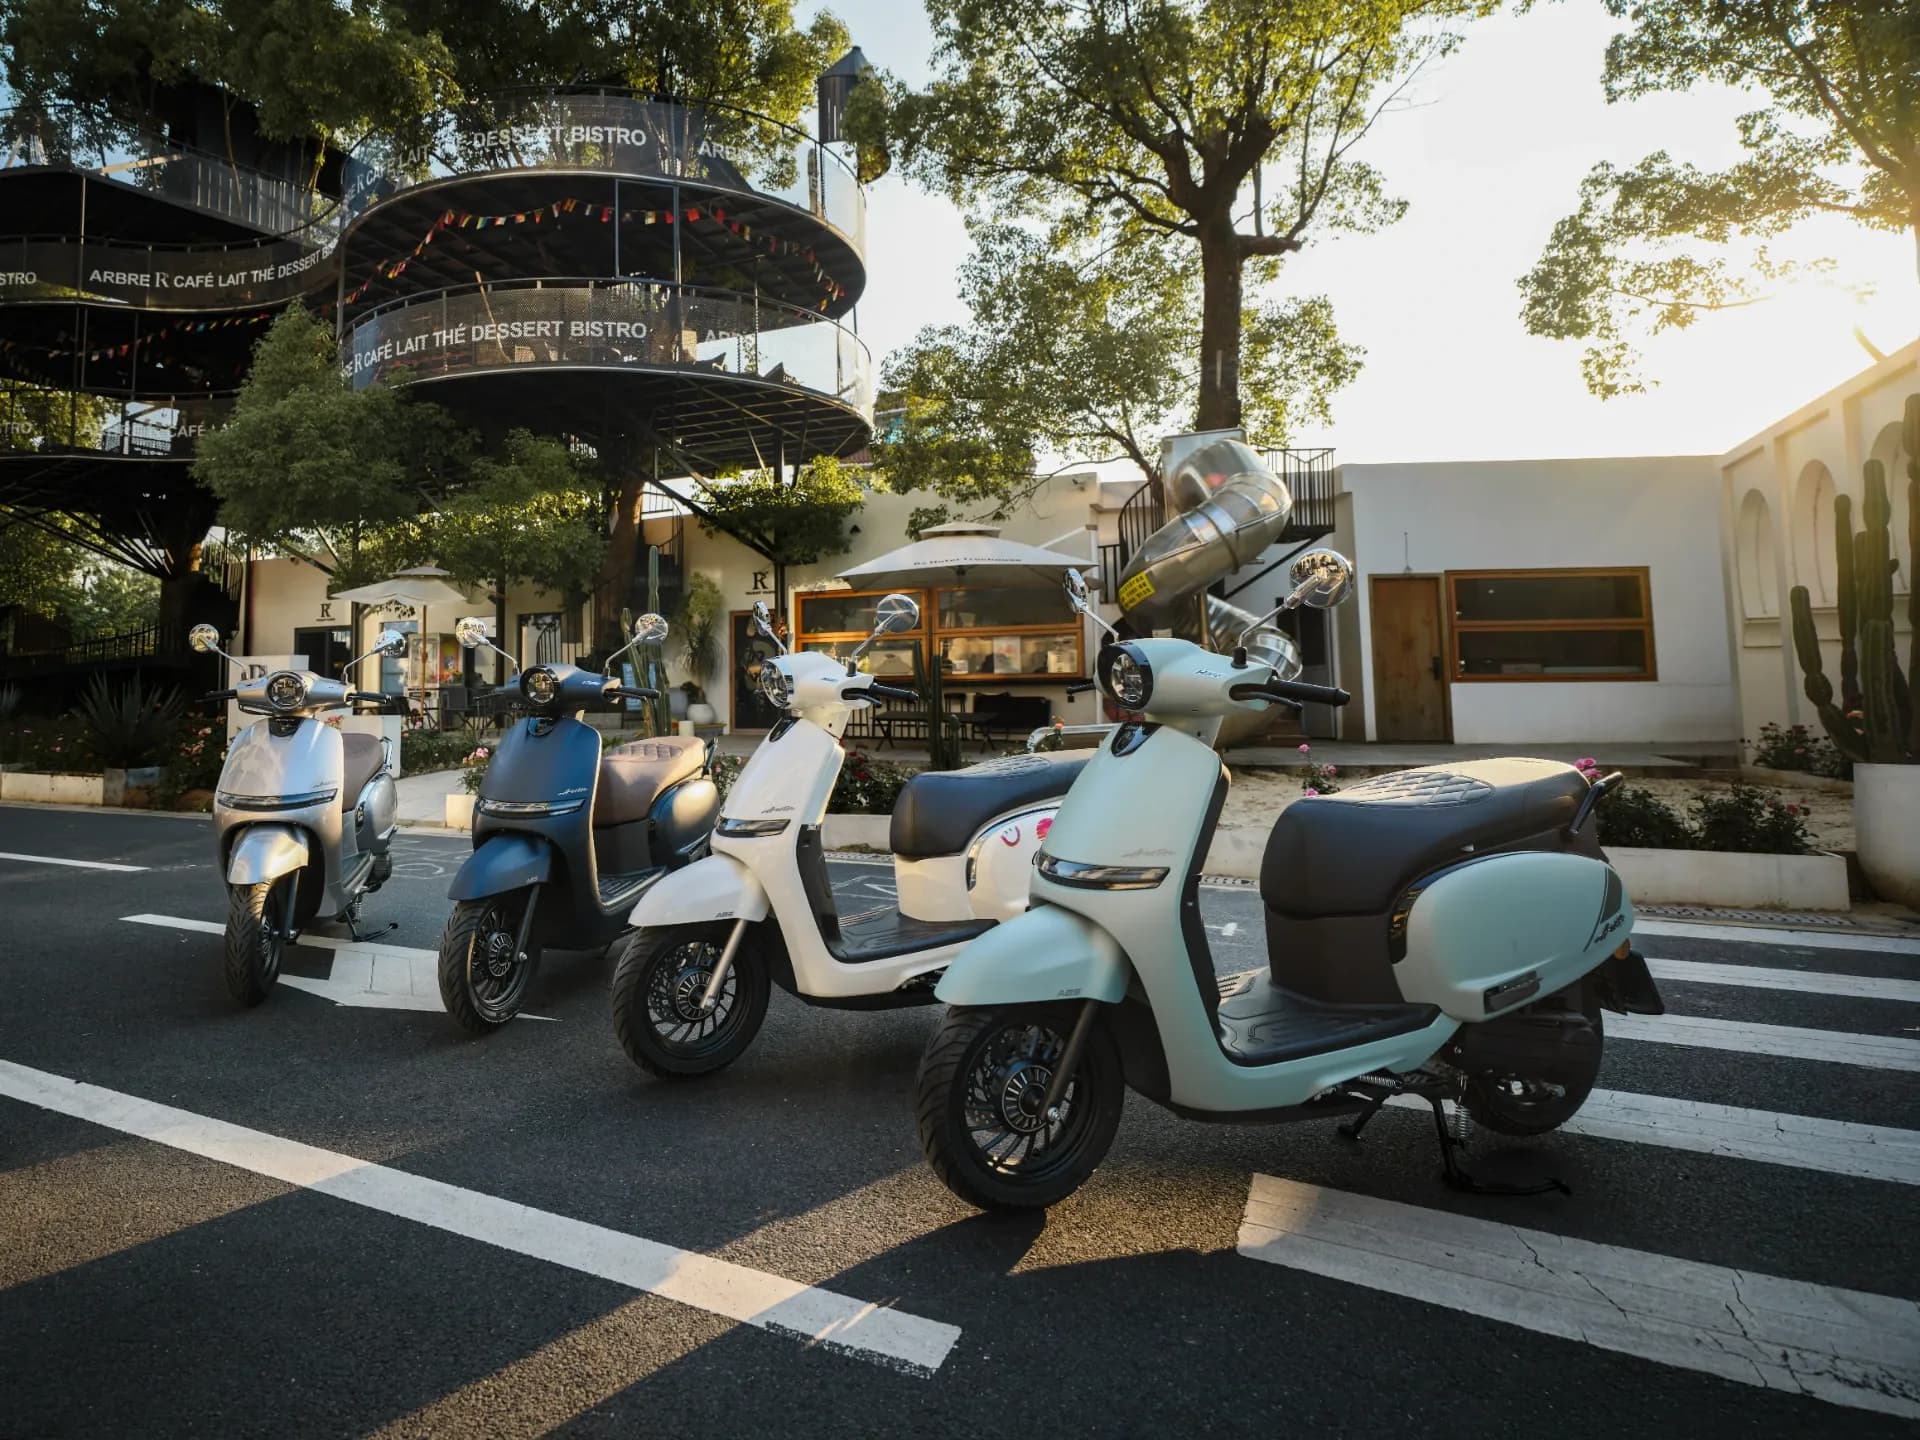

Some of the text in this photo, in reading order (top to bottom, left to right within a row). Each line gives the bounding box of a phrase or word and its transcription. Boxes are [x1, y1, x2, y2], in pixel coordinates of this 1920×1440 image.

[572, 125, 647, 147] BISTRO
[88, 269, 151, 287] ARBRE
[154, 271, 170, 288] R
[173, 272, 214, 288] CAFÉ
[218, 271, 248, 287] LAIT
[251, 264, 275, 283] THÉ
[277, 249, 321, 279] DESSERT
[364, 338, 393, 368] CAFÉ
[396, 333, 429, 356] LAIT
[432, 322, 467, 348] THÉ
[471, 320, 564, 342] DESSERT
[570, 320, 647, 339] BISTRO
[751, 570, 769, 590] R
[319, 603, 332, 618] R
